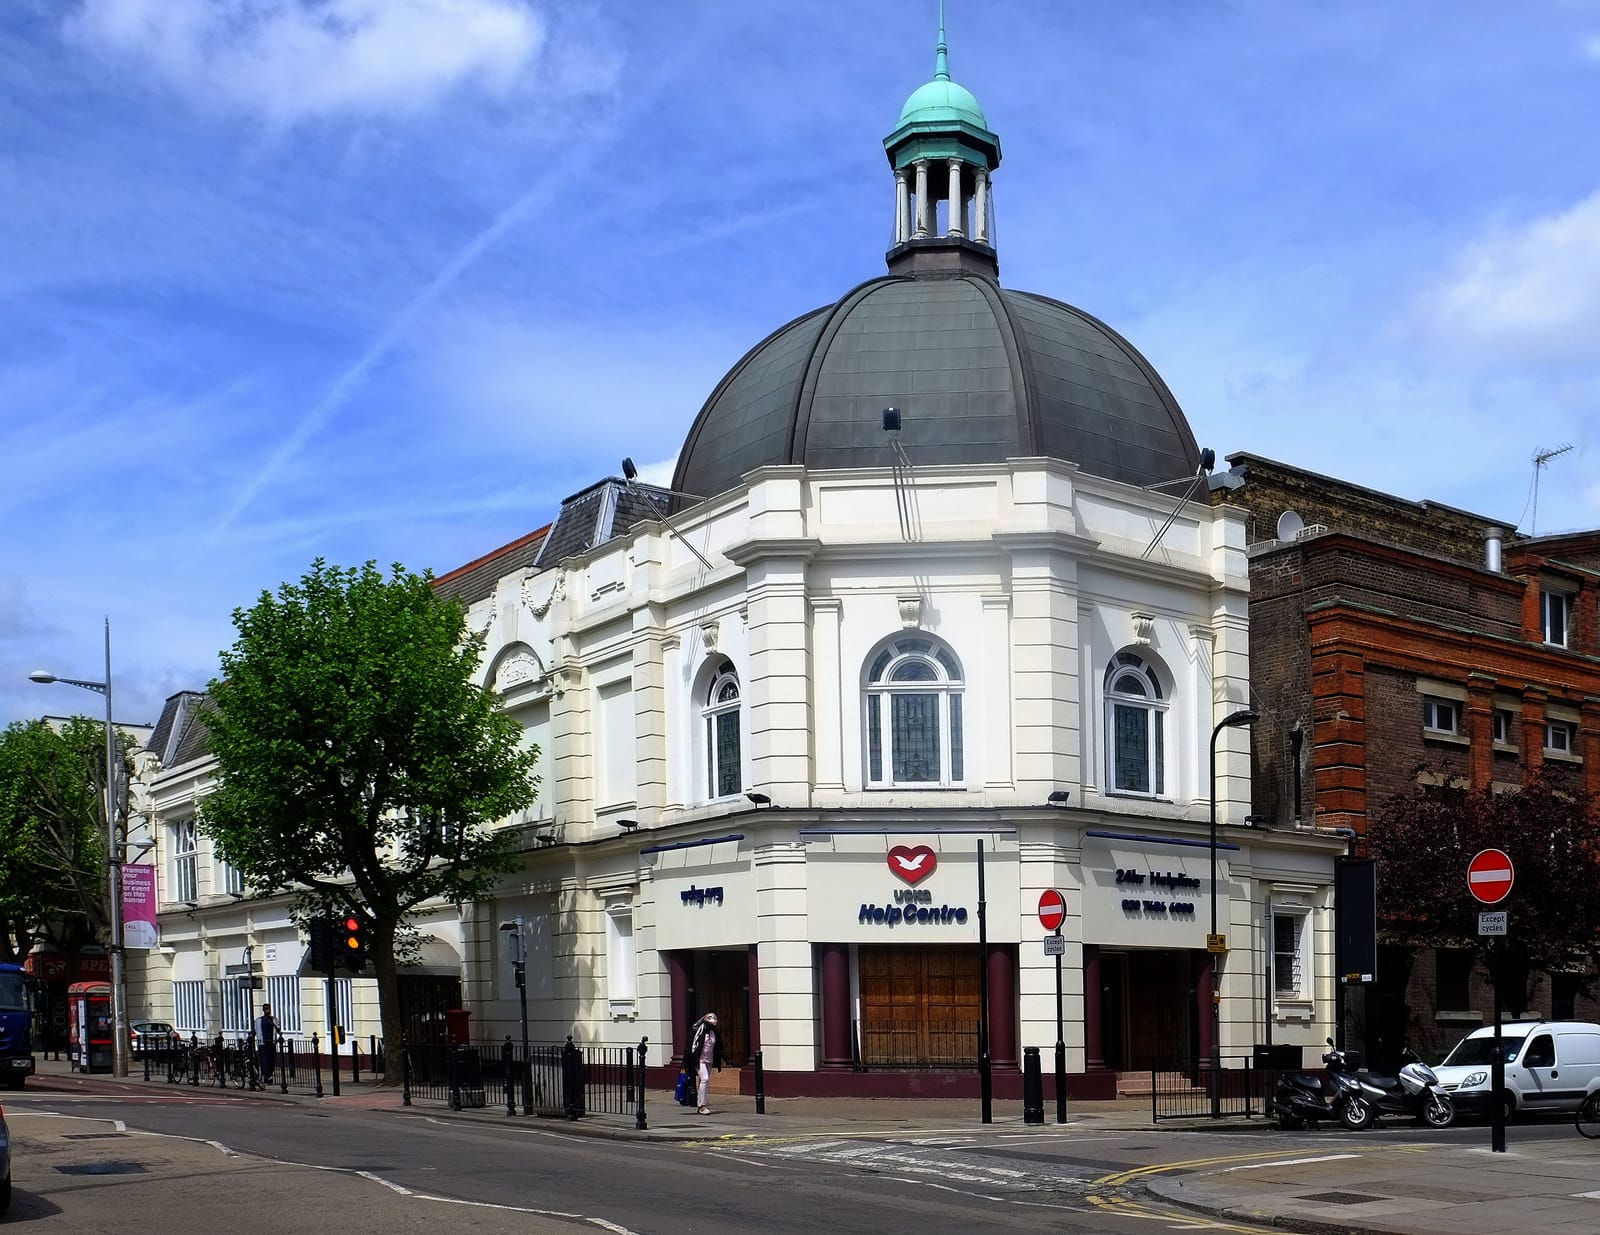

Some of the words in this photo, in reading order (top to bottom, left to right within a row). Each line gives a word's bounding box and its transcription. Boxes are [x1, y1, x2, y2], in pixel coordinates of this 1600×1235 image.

[122, 866, 150, 874] Promote
[1115, 868, 1146, 884] 24hr
[1150, 871, 1200, 890] Helpline
[1481, 915, 1505, 923] Except
[1481, 925, 1504, 934] cycles
